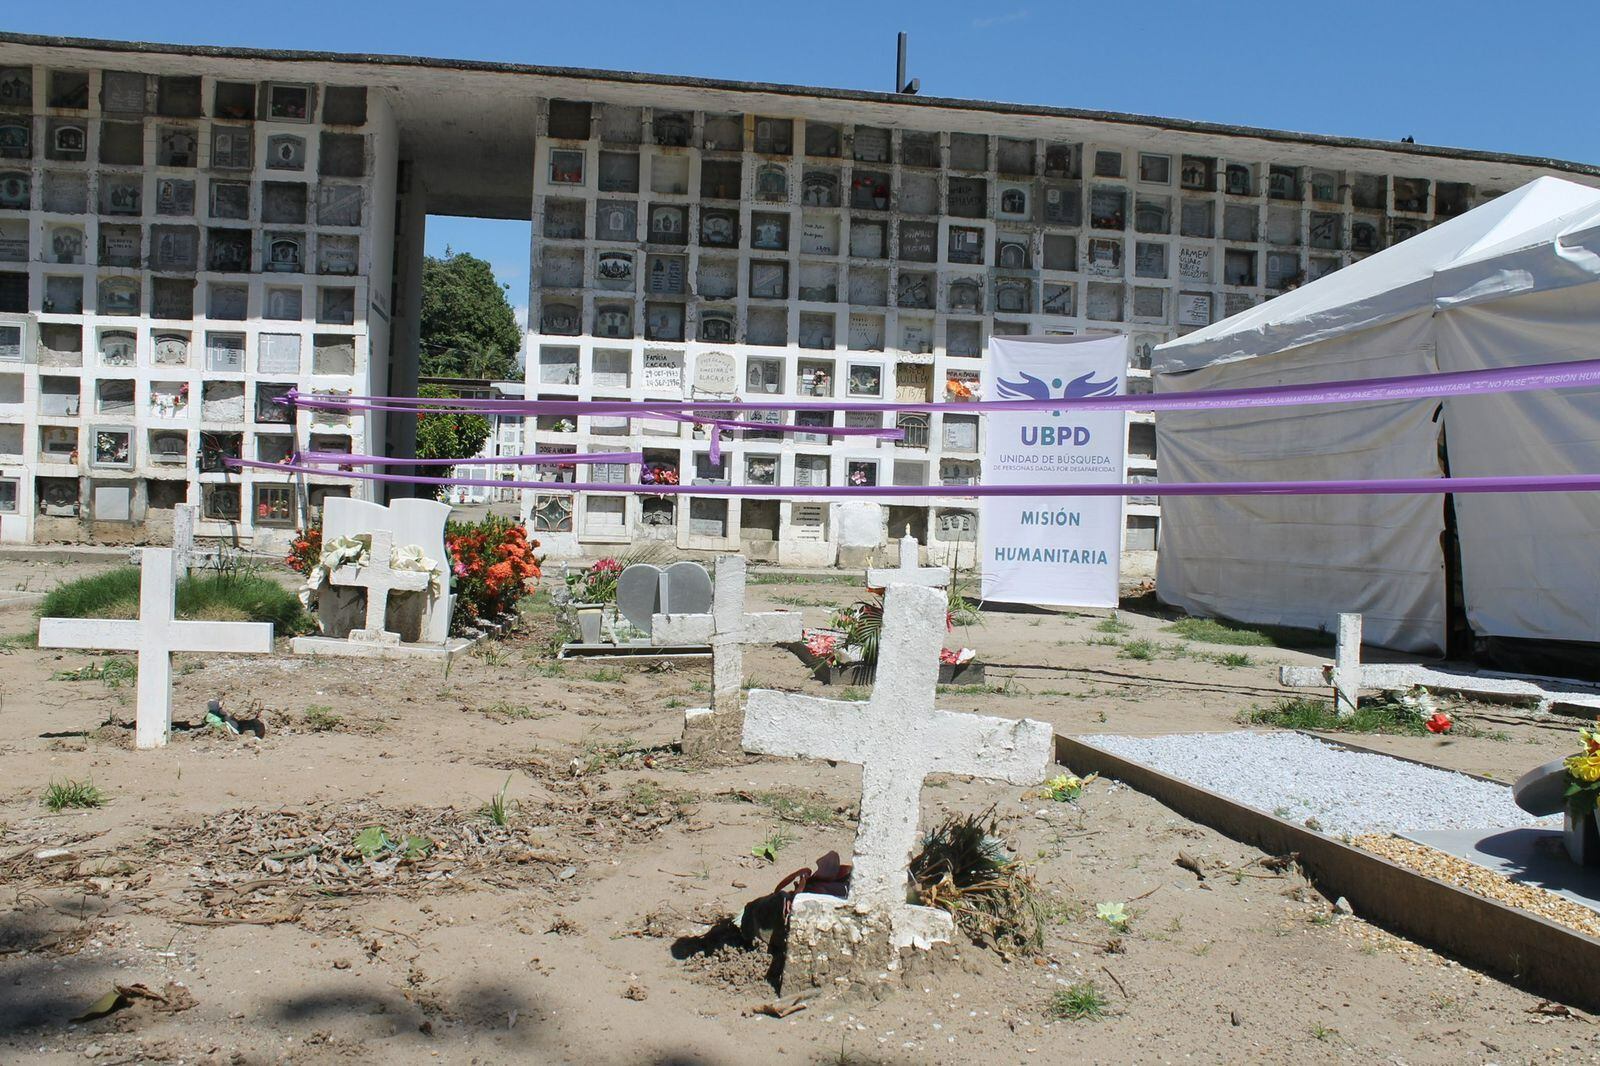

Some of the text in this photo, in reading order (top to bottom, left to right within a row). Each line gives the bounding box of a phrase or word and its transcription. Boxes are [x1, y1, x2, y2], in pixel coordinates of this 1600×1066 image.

[1179, 248, 1208, 259] ARMEN
[1488, 381, 1501, 389] NO
[1502, 378, 1527, 387] PASE
[1021, 426, 1091, 446] UBPD
[999, 453, 1111, 465] UNIDAD DE BÚSQUEDA
[1020, 507, 1080, 527] MISIÓN
[995, 547, 1108, 565] HUMANITARIA
